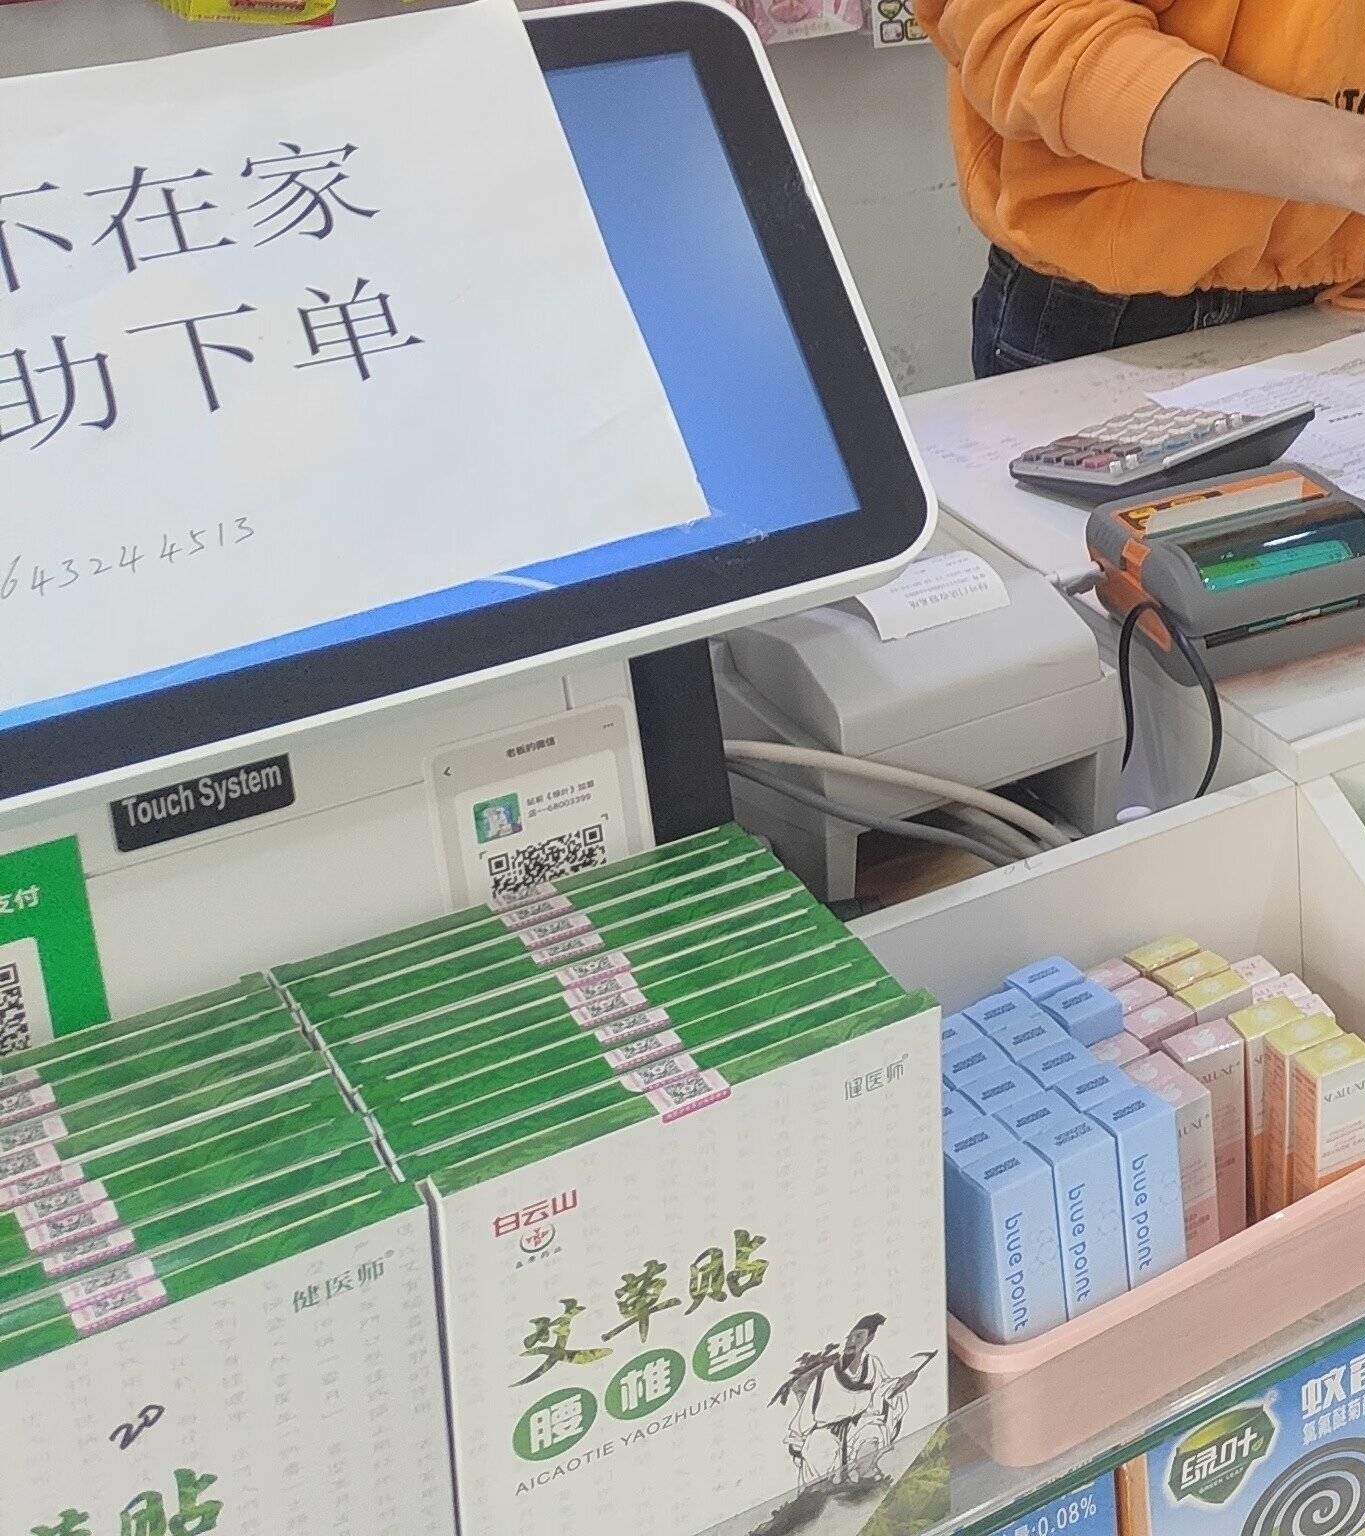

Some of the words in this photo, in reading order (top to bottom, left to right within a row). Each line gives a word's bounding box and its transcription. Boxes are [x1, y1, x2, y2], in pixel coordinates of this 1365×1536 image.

[0, 276, 426, 451] 助下单
[121, 780, 196, 828] Touch
[198, 764, 284, 811] System
[844, 1060, 903, 1102] 健医师
[1069, 1183, 1085, 1236] blue
[1132, 1153, 1149, 1207] blue
[492, 1189, 579, 1238] 白云山
[1005, 1212, 1023, 1266] blue
[1132, 1211, 1152, 1270] point
[291, 1263, 386, 1314] 健医师
[1068, 1242, 1090, 1302] point
[509, 1229, 770, 1388] 艾草贴
[1005, 1272, 1029, 1332] point
[529, 1317, 757, 1454] 腰椎型
[109, 1402, 166, 1449] 20
[515, 1442, 615, 1497] AICAOTIE
[620, 1377, 758, 1447] YAOZHUIXING
[1181, 1426, 1258, 1489] 绿叶
